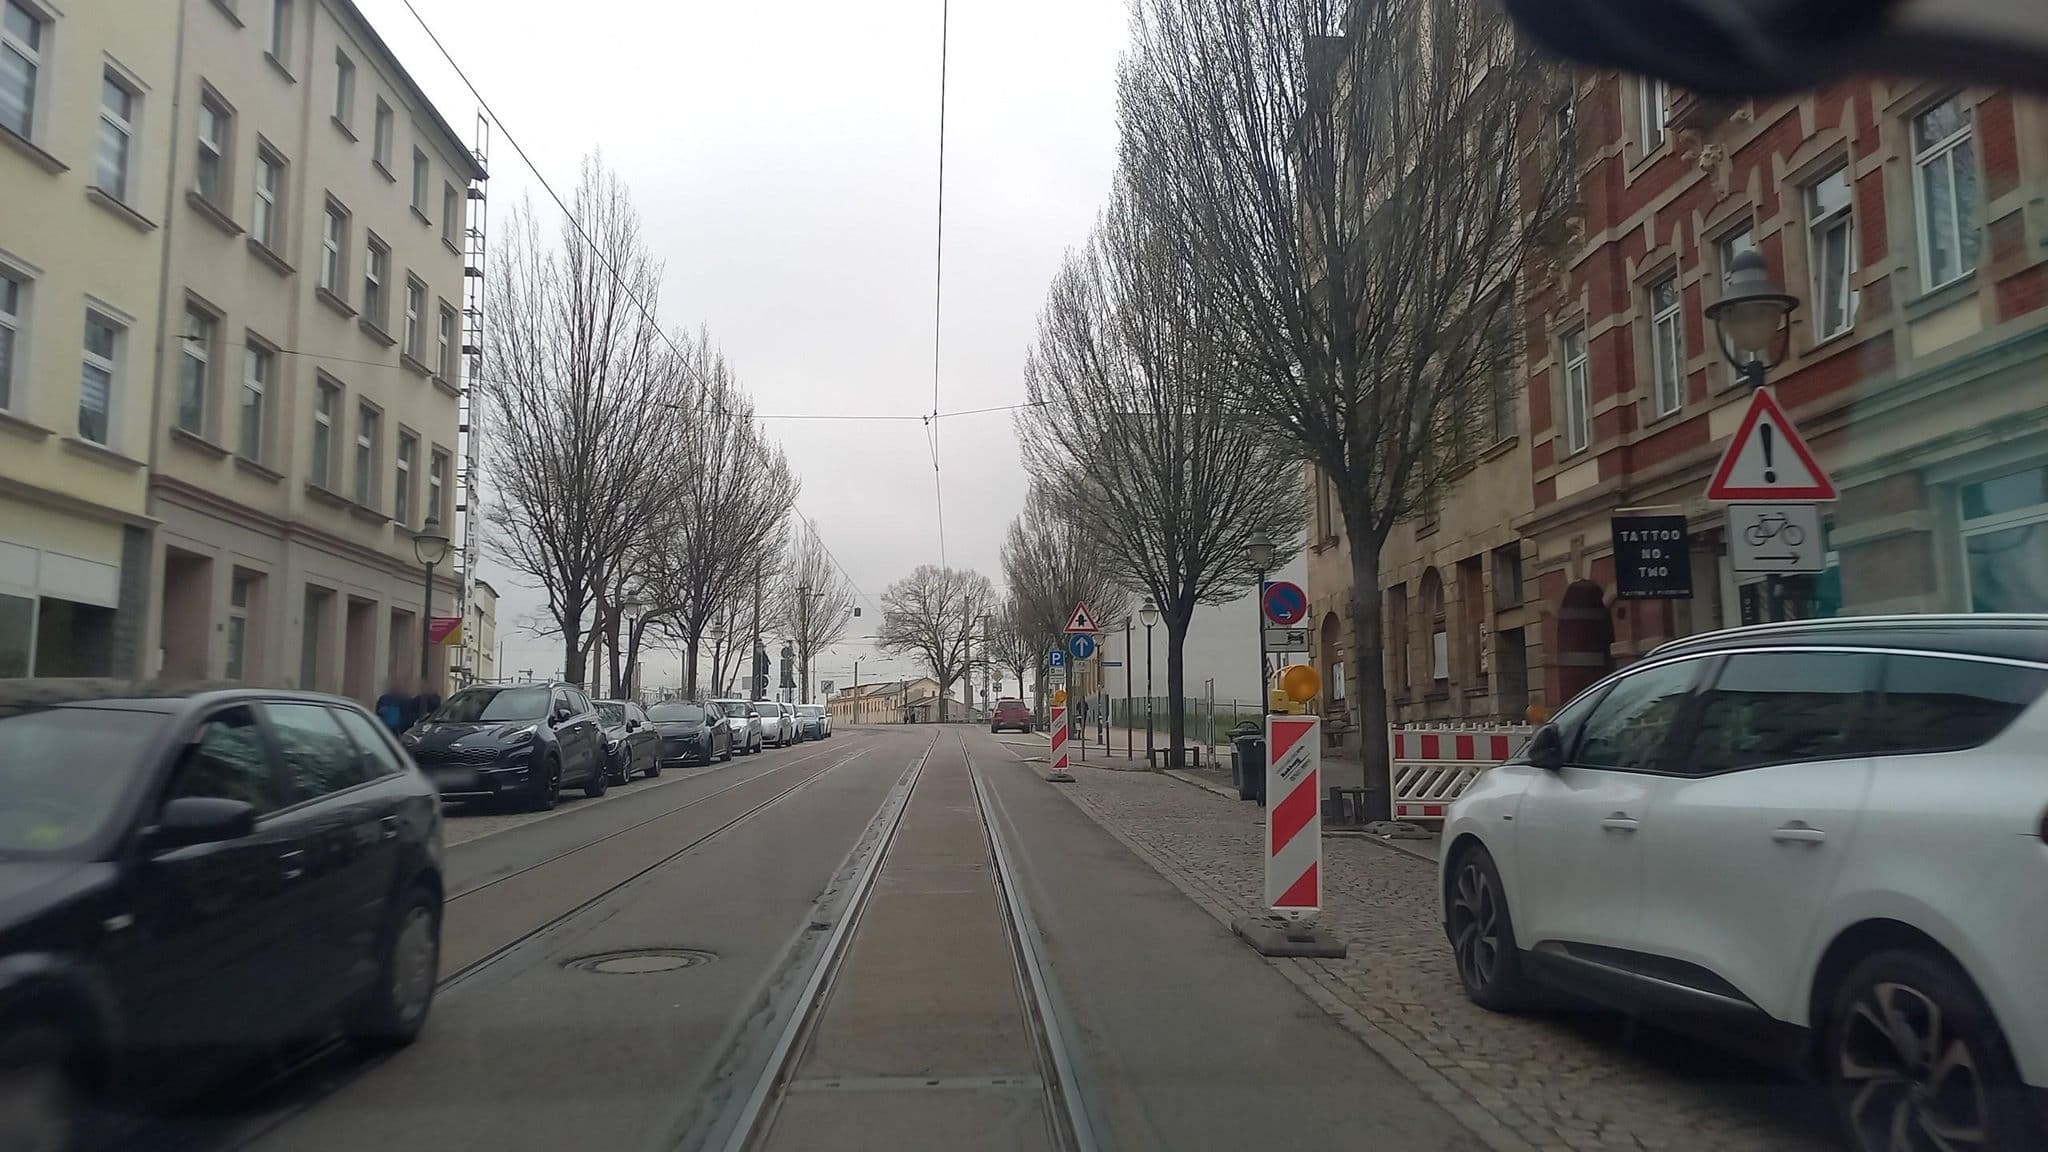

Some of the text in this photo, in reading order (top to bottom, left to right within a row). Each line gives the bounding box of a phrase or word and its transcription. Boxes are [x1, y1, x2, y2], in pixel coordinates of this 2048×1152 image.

[1619, 530, 1681, 542] TATTOO
[1641, 548, 1670, 559] NO.
[1638, 566, 1668, 578] TWO
[1052, 653, 1061, 665] P
